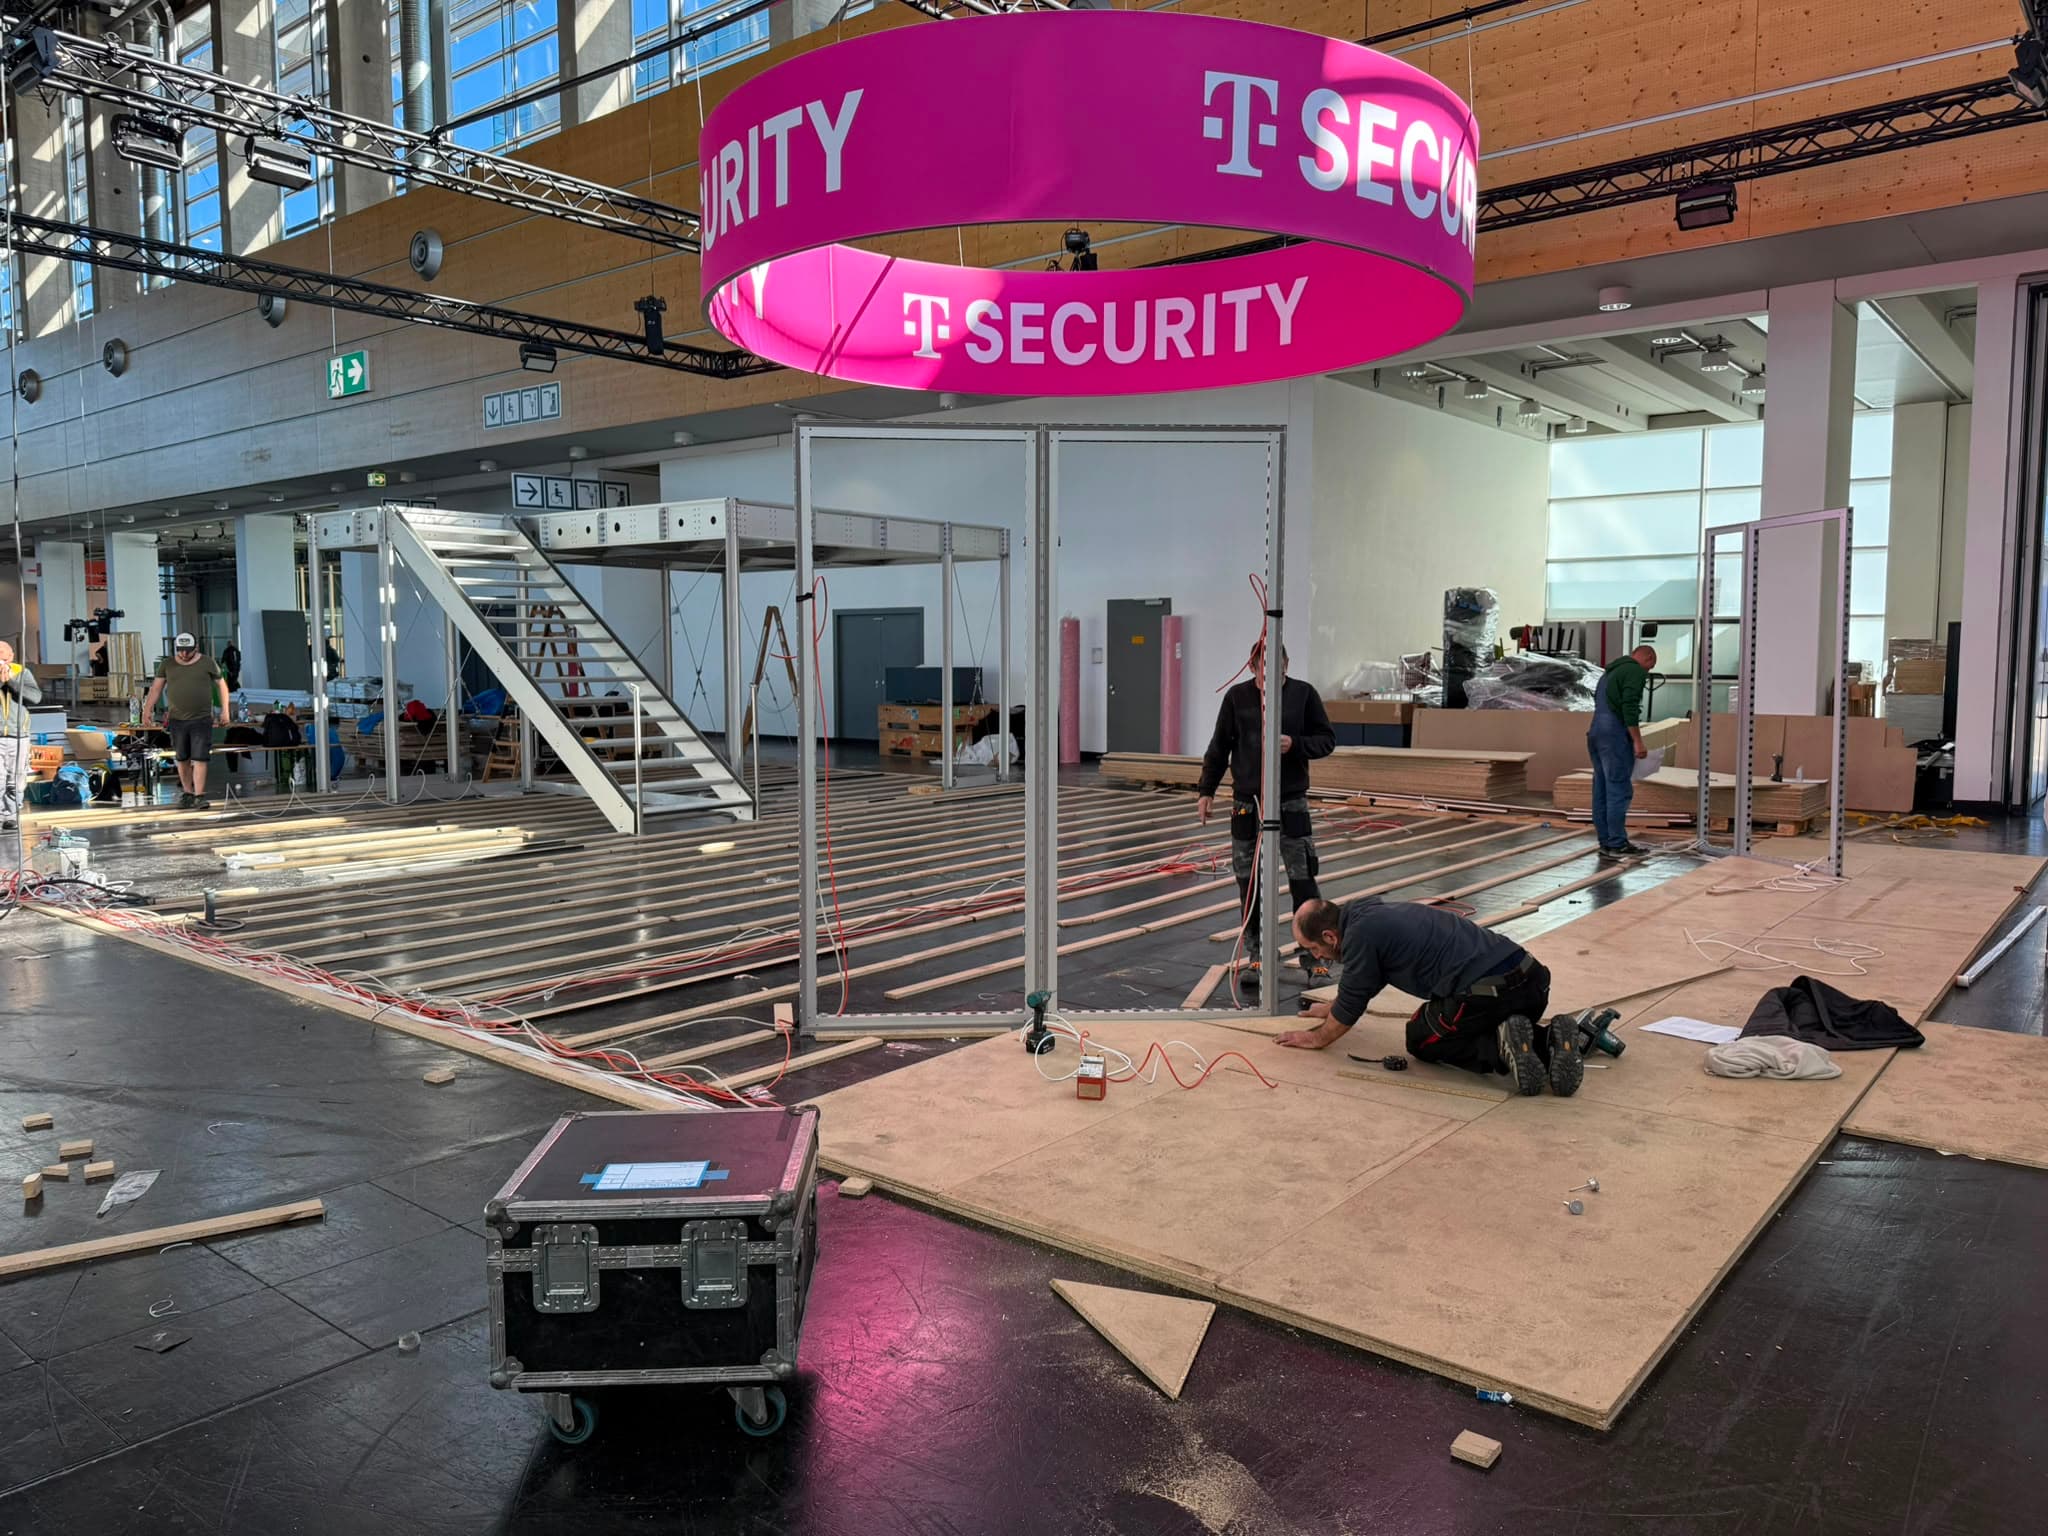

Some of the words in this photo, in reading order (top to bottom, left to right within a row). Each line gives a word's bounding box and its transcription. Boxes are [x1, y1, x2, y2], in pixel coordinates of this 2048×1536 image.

[701, 88, 864, 252] URITY
[1203, 70, 1279, 178] T
[965, 276, 1309, 366] SECURITY
